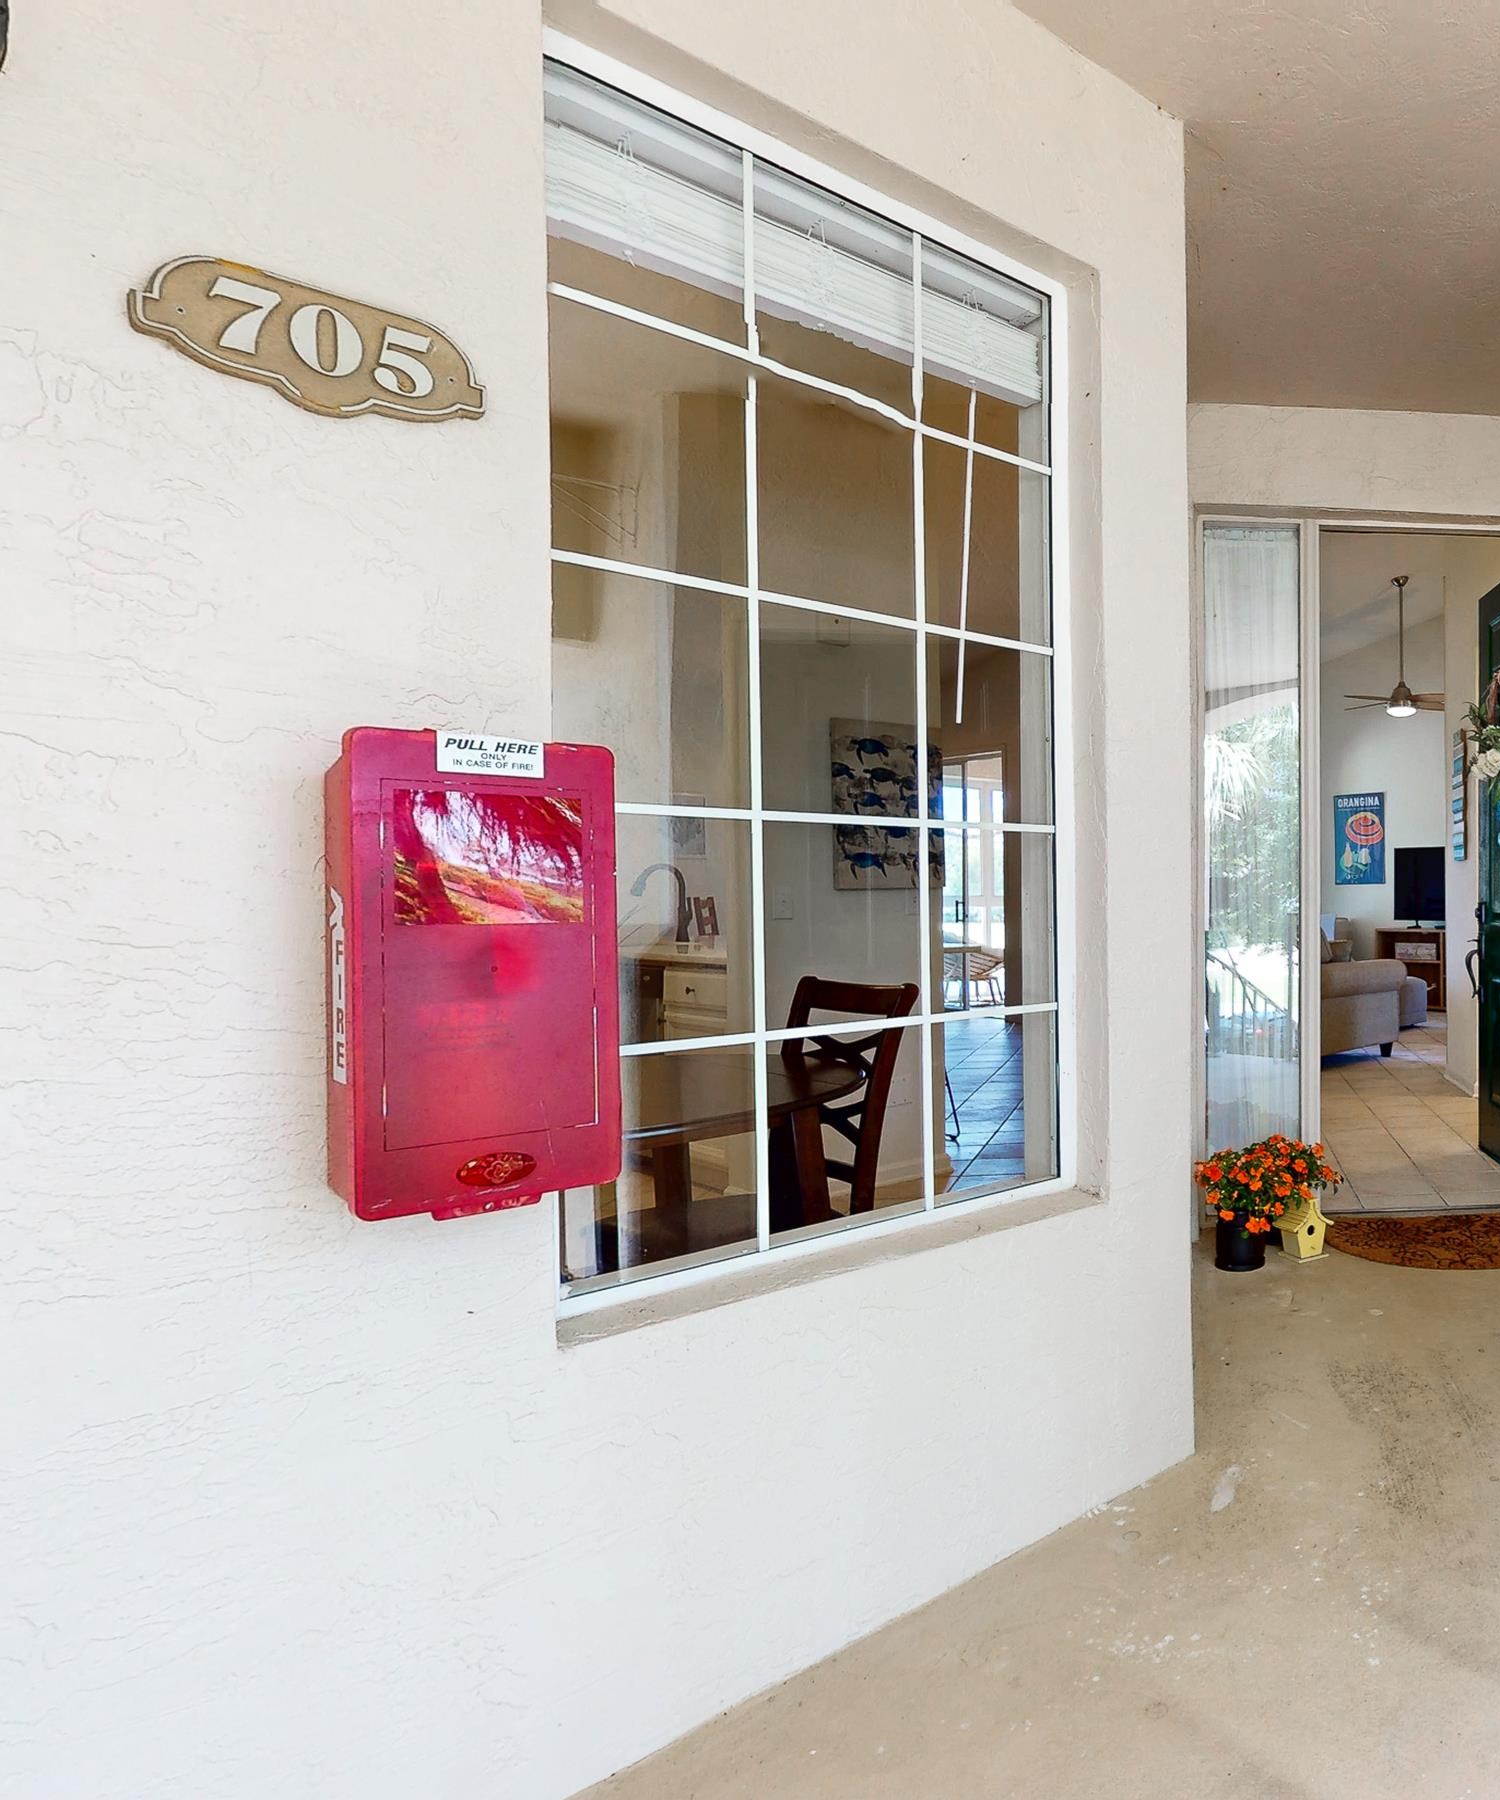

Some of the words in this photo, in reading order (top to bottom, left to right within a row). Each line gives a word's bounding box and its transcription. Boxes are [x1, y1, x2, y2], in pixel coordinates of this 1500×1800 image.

[208, 275, 435, 398] 705
[445, 738, 488, 751] PULL
[495, 742, 539, 755] HERE
[466, 759, 492, 768] CASE
[495, 761, 508, 769] OF
[1337, 796, 1380, 808] ORANGINA
[335, 939, 344, 1069] FIRE
